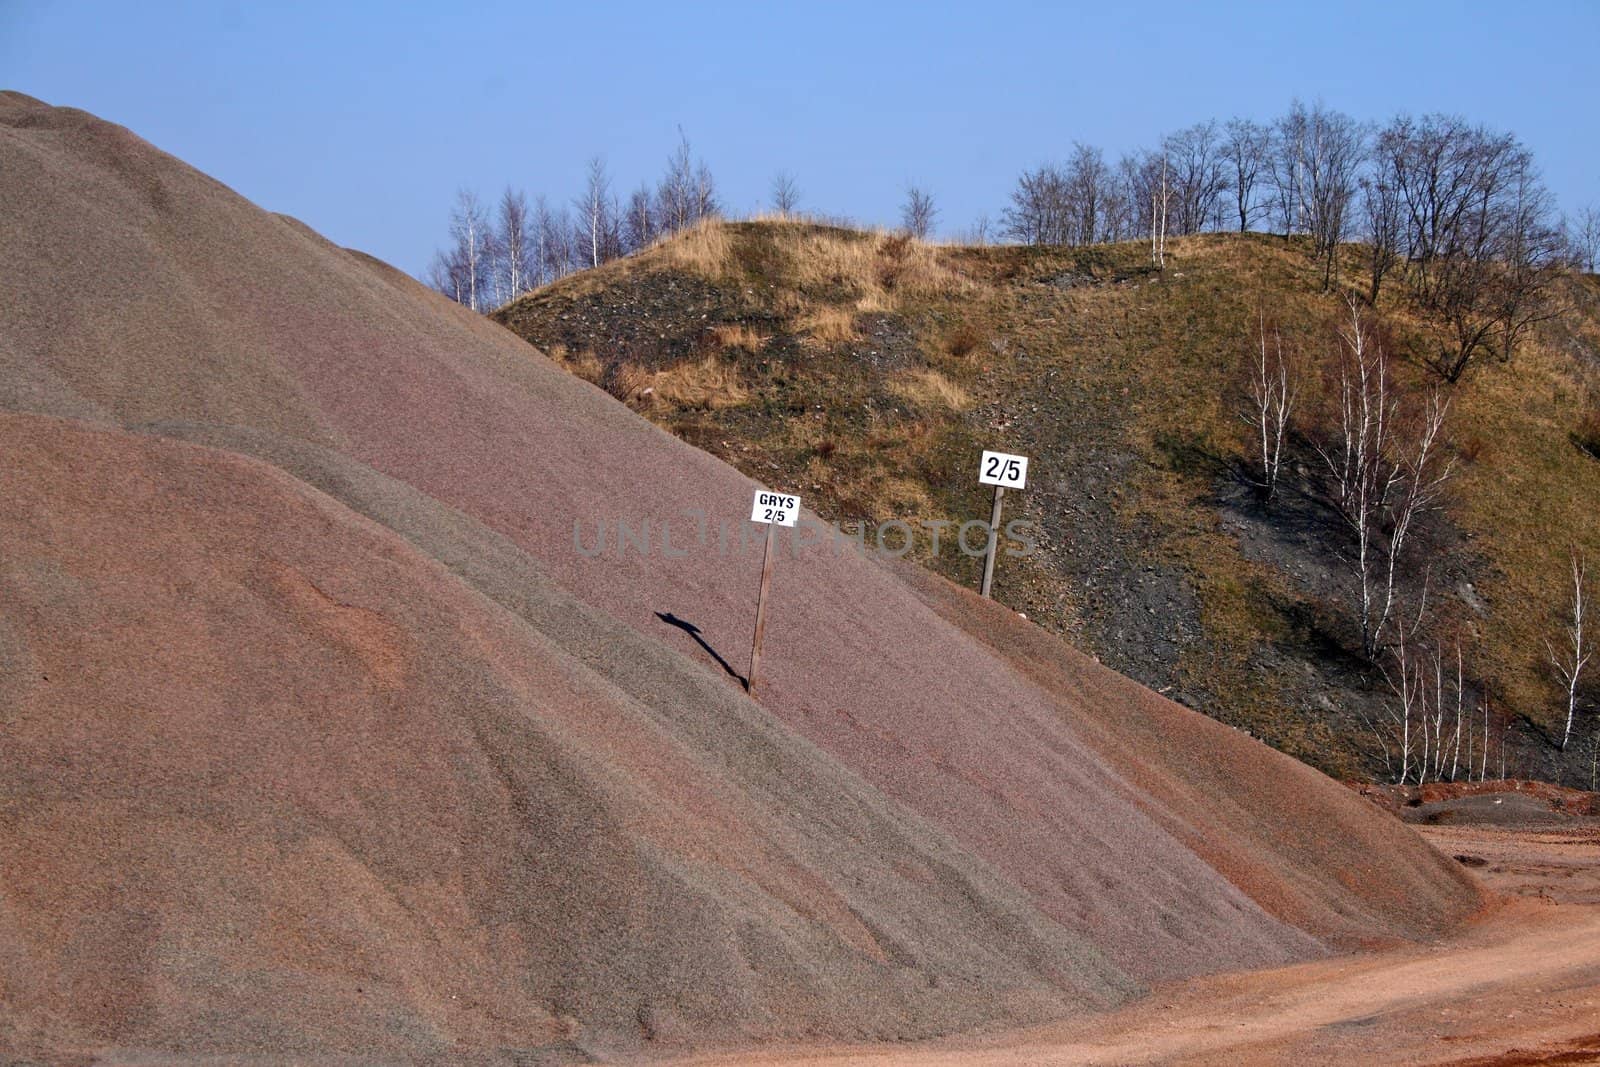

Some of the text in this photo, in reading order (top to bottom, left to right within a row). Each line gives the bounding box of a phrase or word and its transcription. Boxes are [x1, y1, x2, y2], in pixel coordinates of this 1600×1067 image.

[986, 457, 1020, 481] 2/5
[759, 493, 794, 509] GRYS
[764, 508, 785, 522] 2/5
